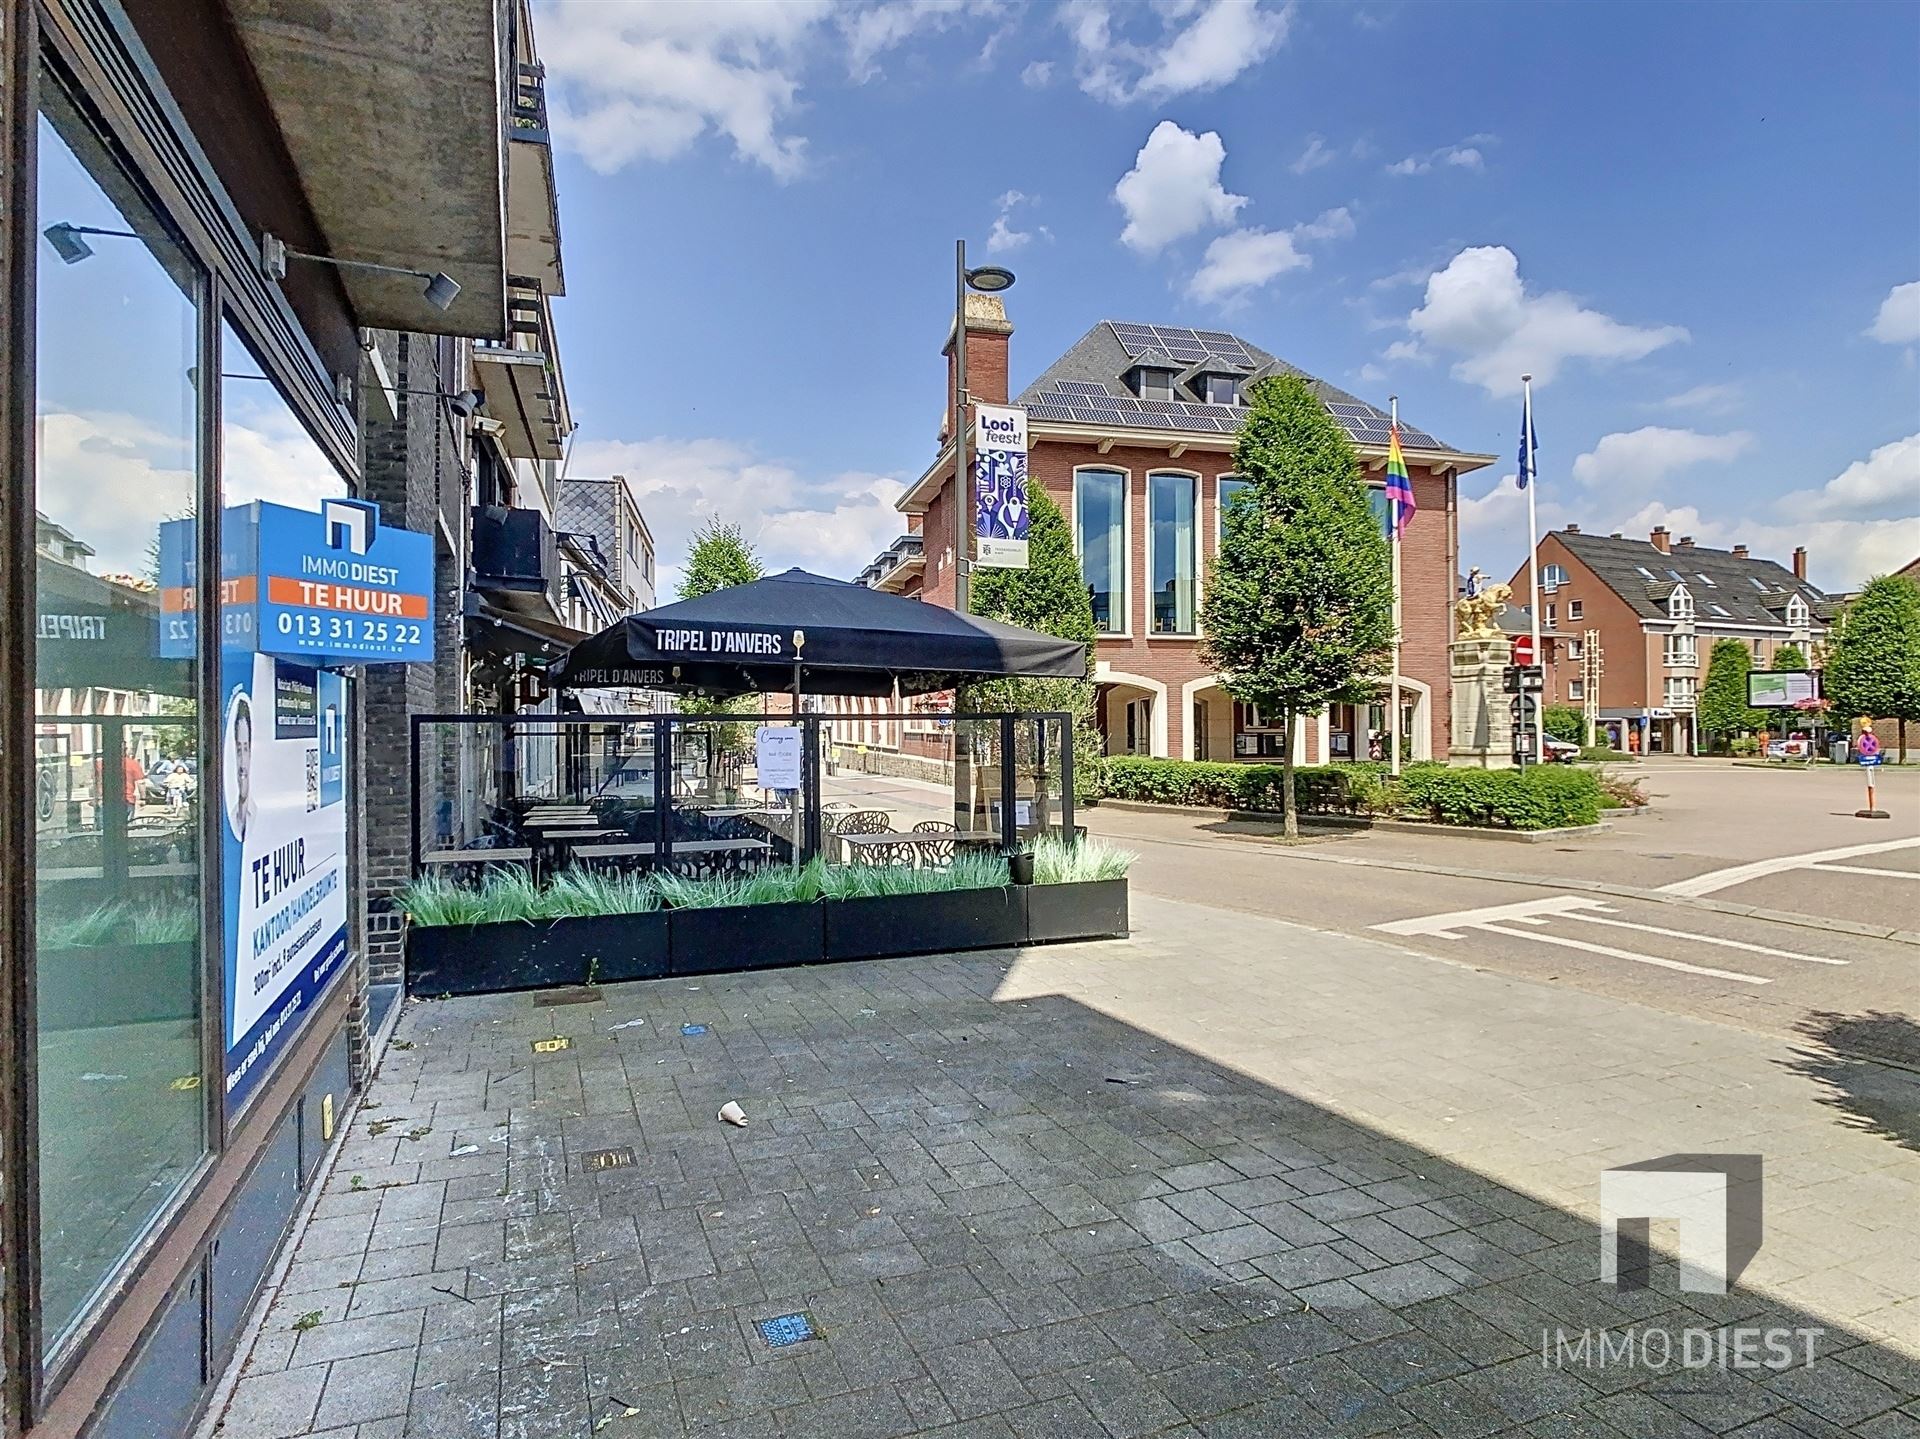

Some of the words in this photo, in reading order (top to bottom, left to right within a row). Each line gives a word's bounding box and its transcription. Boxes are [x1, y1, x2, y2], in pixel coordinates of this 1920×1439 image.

[981, 414, 1014, 431] Looi
[986, 430, 1021, 445] feest!
[302, 554, 349, 579] IMMO
[351, 563, 399, 586] DIEST
[299, 581, 330, 607] TE
[335, 586, 403, 615] HUUR
[278, 612, 321, 636] 013
[329, 617, 353, 639] 31
[363, 621, 388, 642] 25
[395, 624, 421, 645] 22
[655, 629, 707, 652] TRIPEL
[711, 631, 782, 655] D'ANVERS
[612, 669, 664, 684] D'ANVERS
[252, 854, 270, 909] TE
[274, 837, 306, 896] HUUR
